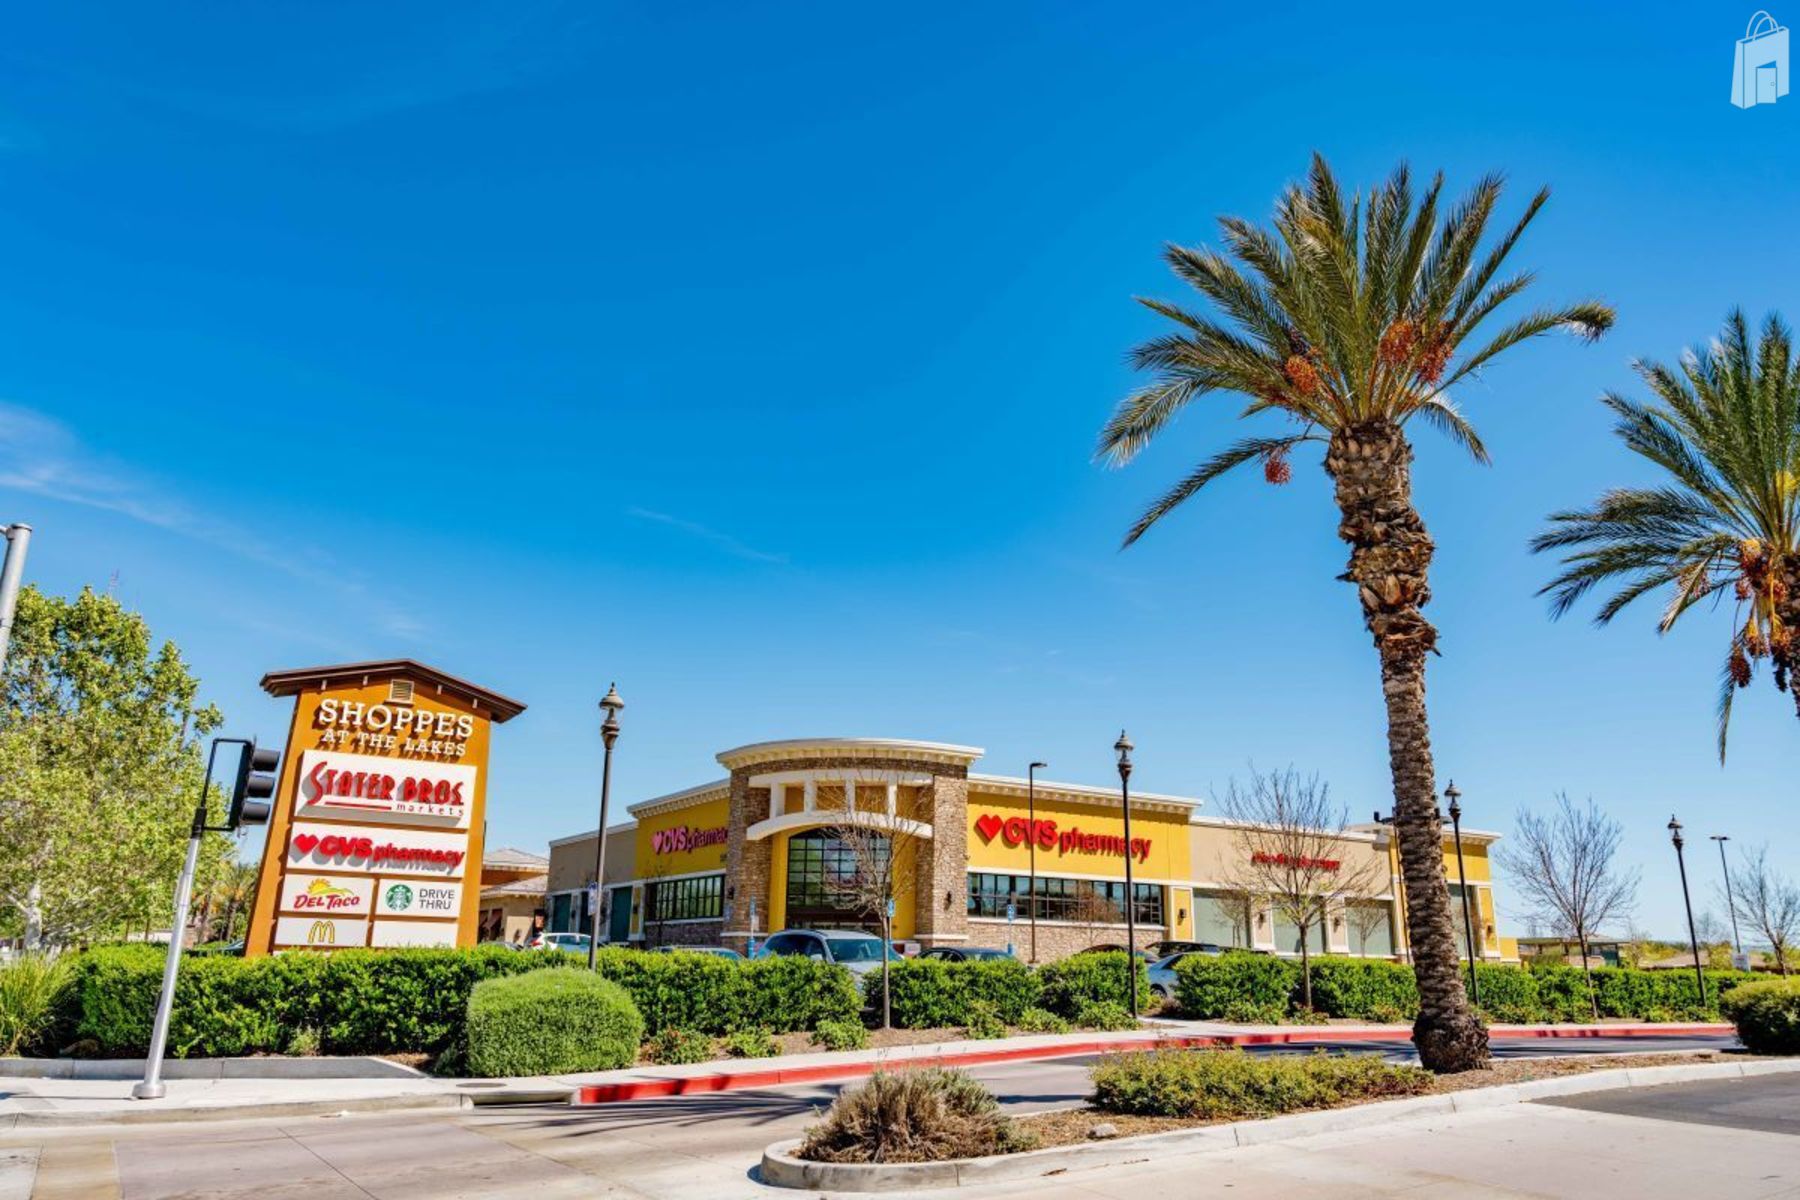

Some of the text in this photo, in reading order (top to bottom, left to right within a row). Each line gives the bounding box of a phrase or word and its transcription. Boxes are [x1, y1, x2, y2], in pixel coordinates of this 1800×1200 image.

[319, 698, 474, 738] SHOPPES
[321, 729, 466, 757] AT THE LAKES
[306, 761, 464, 806] STATER BROS
[396, 803, 464, 816] markets
[663, 826, 688, 854] CVS
[1002, 817, 1058, 849] CVS
[318, 835, 466, 869] CVS pharmacy
[294, 894, 361, 910] DEL TACO
[419, 888, 455, 900] DRIVE
[419, 899, 452, 910] THRU
